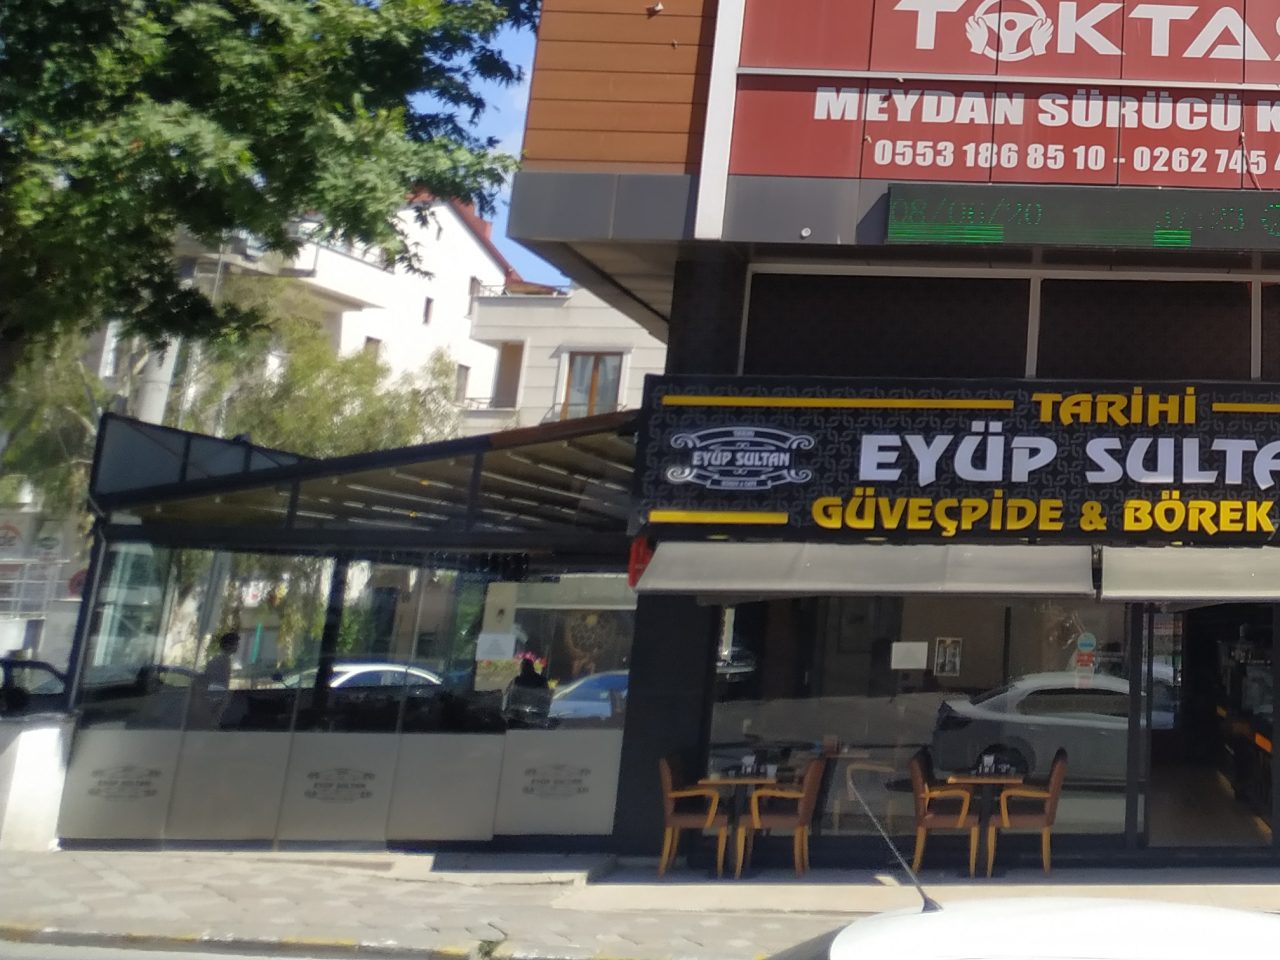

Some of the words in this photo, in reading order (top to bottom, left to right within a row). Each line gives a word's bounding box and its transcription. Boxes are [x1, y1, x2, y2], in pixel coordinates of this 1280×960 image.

[813, 86, 1025, 126] MEYDAN
[1037, 88, 1243, 132] SÜRÜCÜ
[873, 139, 955, 168] 0553
[962, 142, 1019, 170] 186
[1026, 144, 1065, 171] 85
[1072, 144, 1106, 172] 10
[1132, 146, 1208, 174] 0262
[1214, 148, 1267, 176] 745
[1032, 386, 1197, 427] TARİHİ
[735, 451, 790, 468] SULTAN
[858, 420, 1059, 488] EYÜP
[811, 486, 1065, 538] GÜVEÇPİDE
[1080, 503, 1108, 532] &
[1122, 489, 1279, 535] BÖREK
